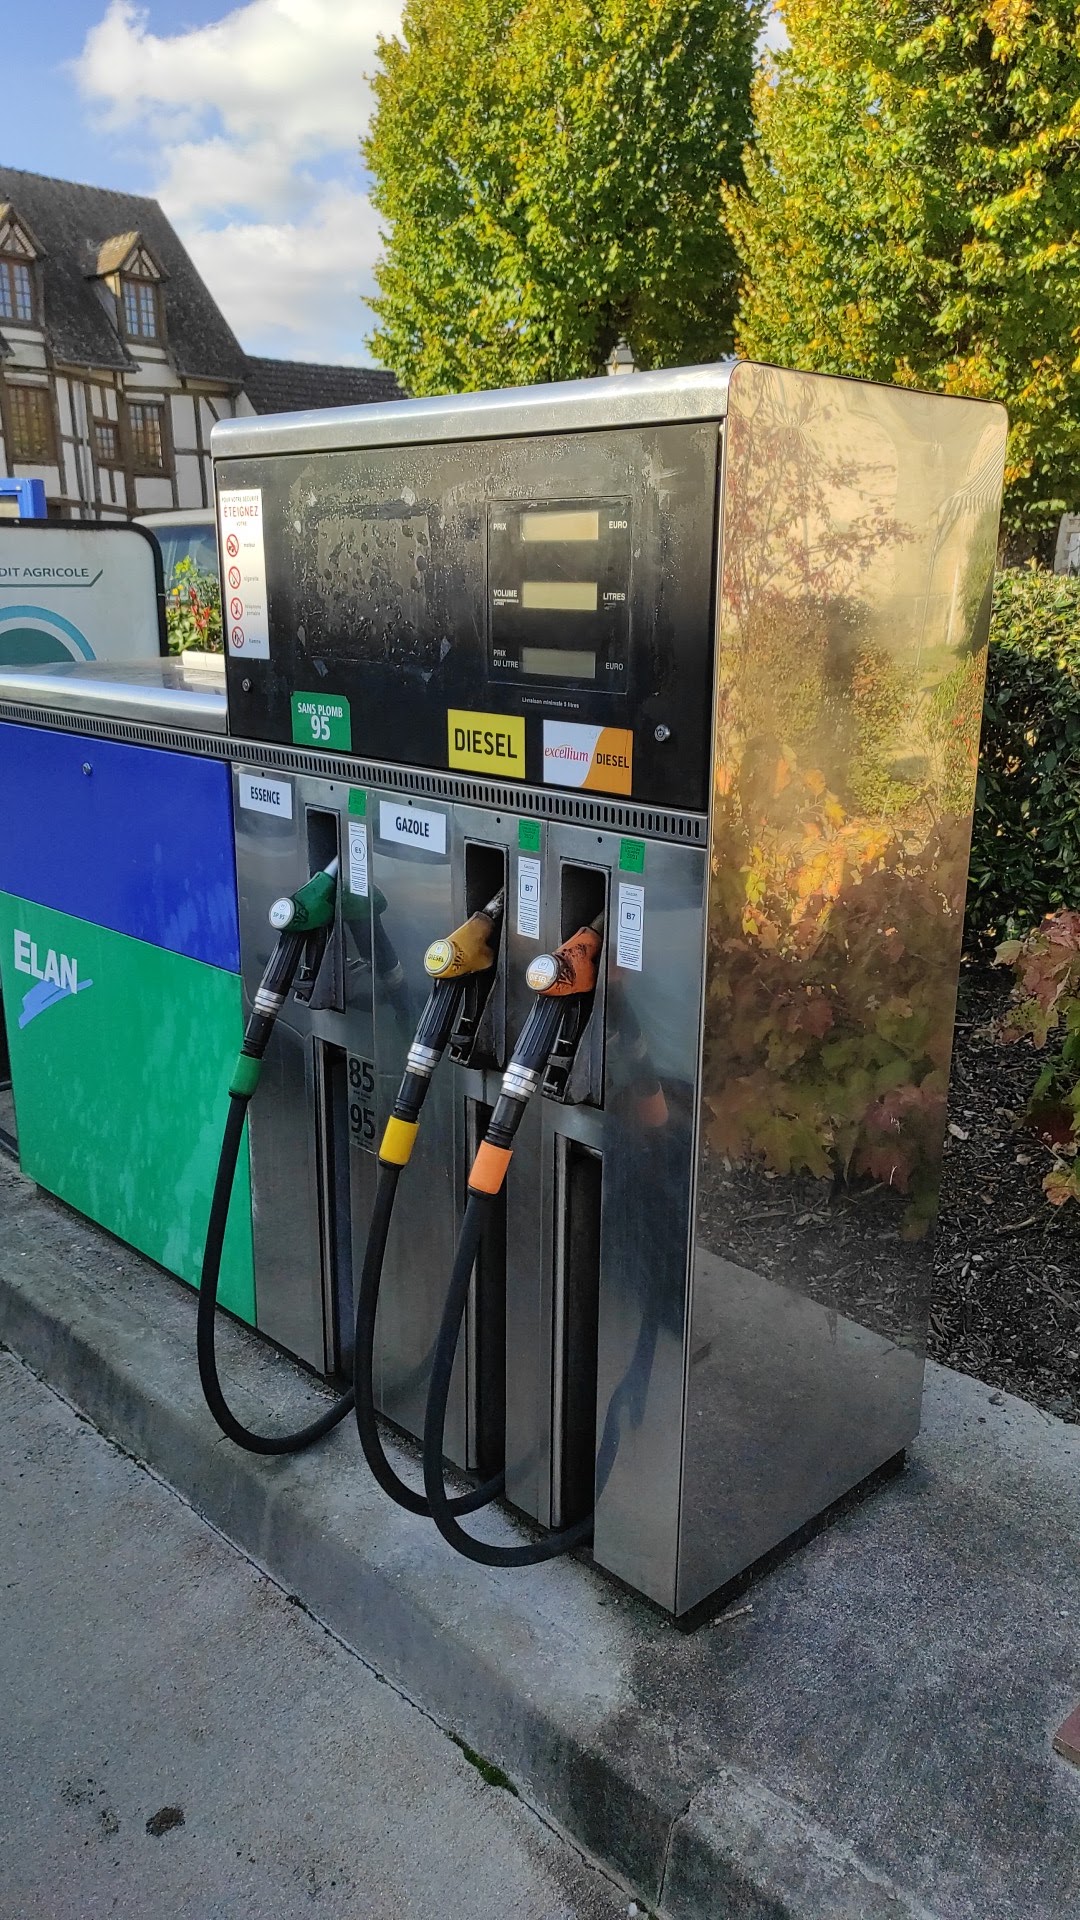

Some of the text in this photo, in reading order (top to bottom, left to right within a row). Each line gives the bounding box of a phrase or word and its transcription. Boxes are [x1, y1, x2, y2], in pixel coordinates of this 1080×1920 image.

[223, 504, 259, 518] ÉTEIGNEZ
[493, 522, 507, 531] PRIX
[608, 520, 628, 529] EURO
[23, 567, 89, 577] AGRICOLE
[493, 589, 518, 598] VOLUME
[603, 592, 626, 601] LITRES
[493, 649, 507, 657] PRIX
[493, 659, 519, 669] DU LITRE
[605, 662, 624, 671] EURO
[297, 702, 343, 718] SANS PLOMB
[310, 714, 331, 741] 95
[454, 728, 518, 759] DIESEL
[544, 744, 630, 769] excellium DIESEL
[250, 786, 281, 805] ESSENCE
[395, 816, 430, 838] GAZOLE
[525, 884, 534, 893] B7
[626, 912, 636, 921] B7
[14, 928, 78, 995] ELAN
[427, 953, 444, 963] DIESEL
[349, 1057, 375, 1093] 85
[350, 1103, 376, 1140] 95
